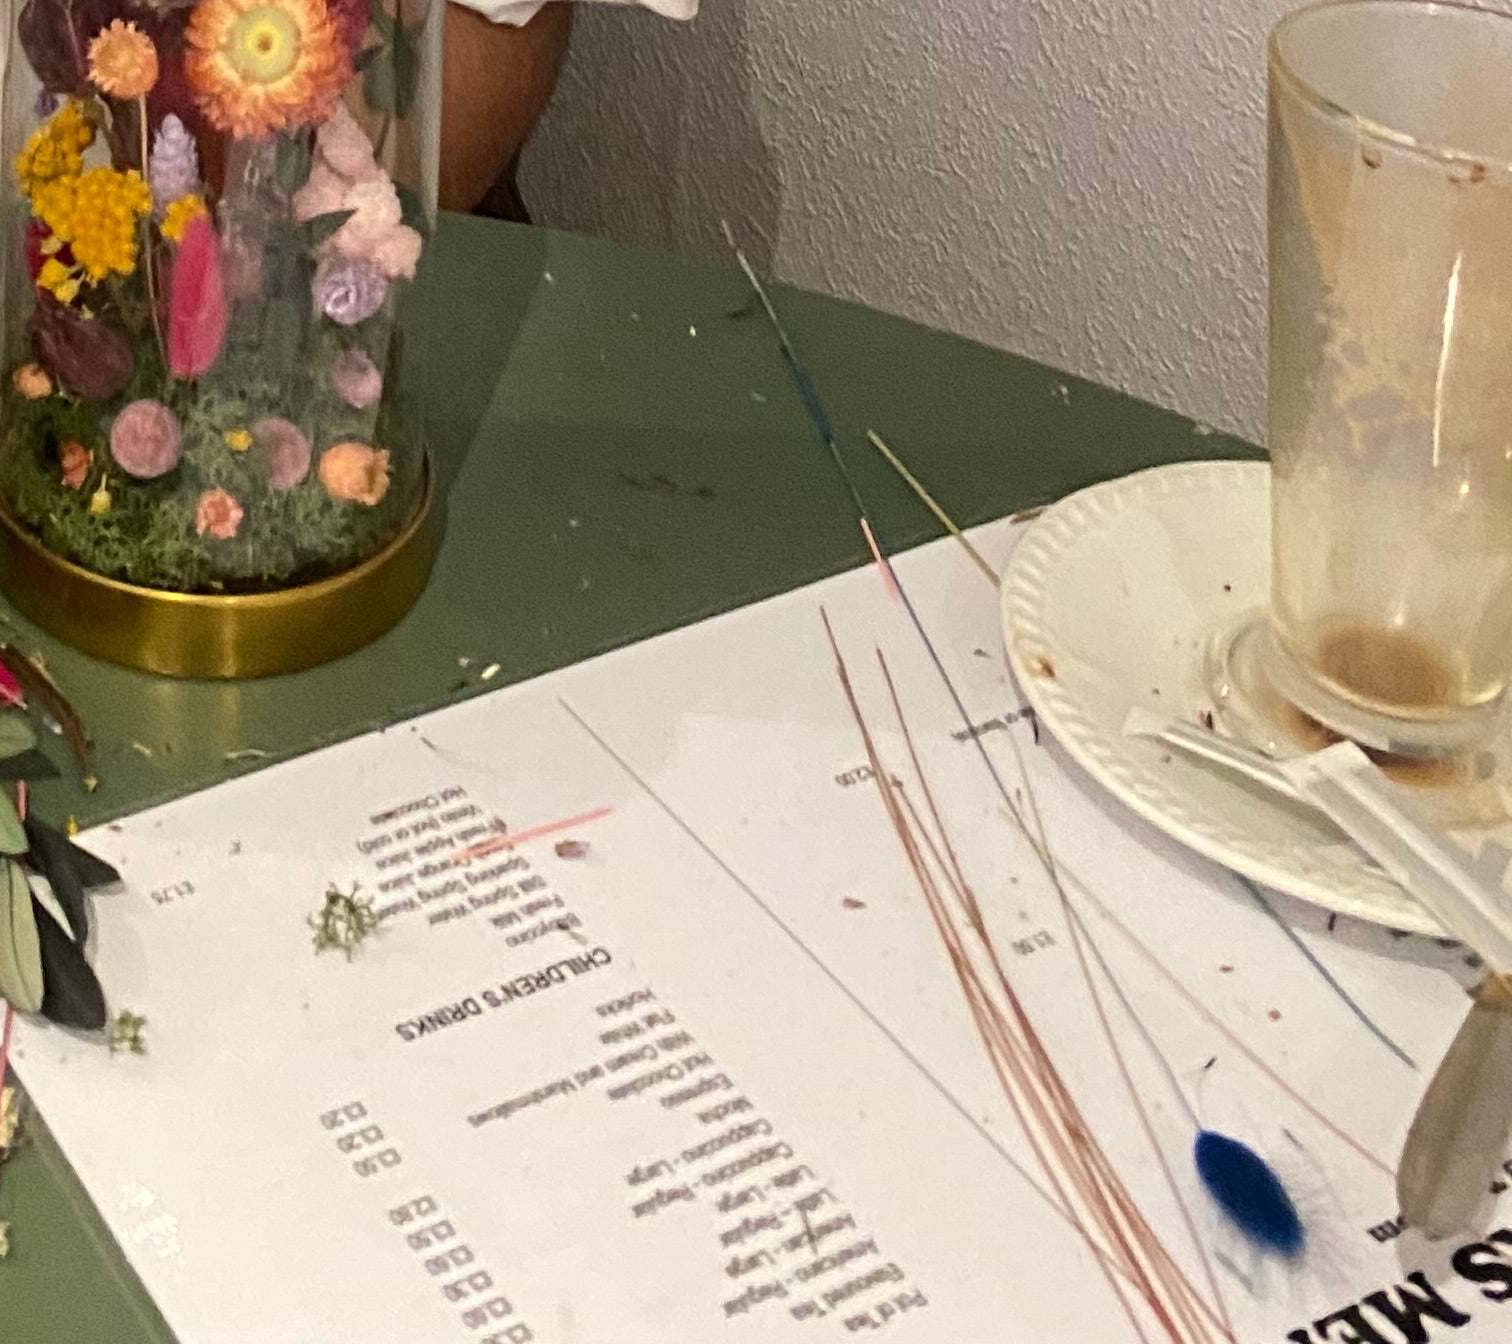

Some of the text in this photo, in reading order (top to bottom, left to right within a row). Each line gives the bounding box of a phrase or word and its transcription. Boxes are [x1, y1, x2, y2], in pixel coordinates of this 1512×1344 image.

[369, 786, 467, 826] Hot Chocolate
[378, 873, 414, 893] Juice
[417, 880, 468, 904] Spring
[467, 886, 519, 910] Spring
[521, 894, 565, 916] Fresh
[428, 903, 472, 926] Water
[395, 947, 612, 1042] CHILDREN'S DRINKS
[467, 1030, 695, 1128] With Cream and Marshmallows
[606, 1052, 714, 1101] Hot Chocolate
[696, 1095, 754, 1124] Mocha
[680, 1118, 773, 1164] Cappuccino
[626, 1159, 674, 1187] Large
[701, 1141, 794, 1187] Cappuccino
[631, 1185, 696, 1219] Regular
[715, 1185, 765, 1213] Large
[718, 1213, 783, 1249] Regular
[724, 1250, 775, 1279] Large
[794, 1237, 879, 1283] Americano
[721, 1280, 789, 1319] Regular
[789, 1300, 827, 1322] Tea
[843, 1313, 881, 1332] Tea
